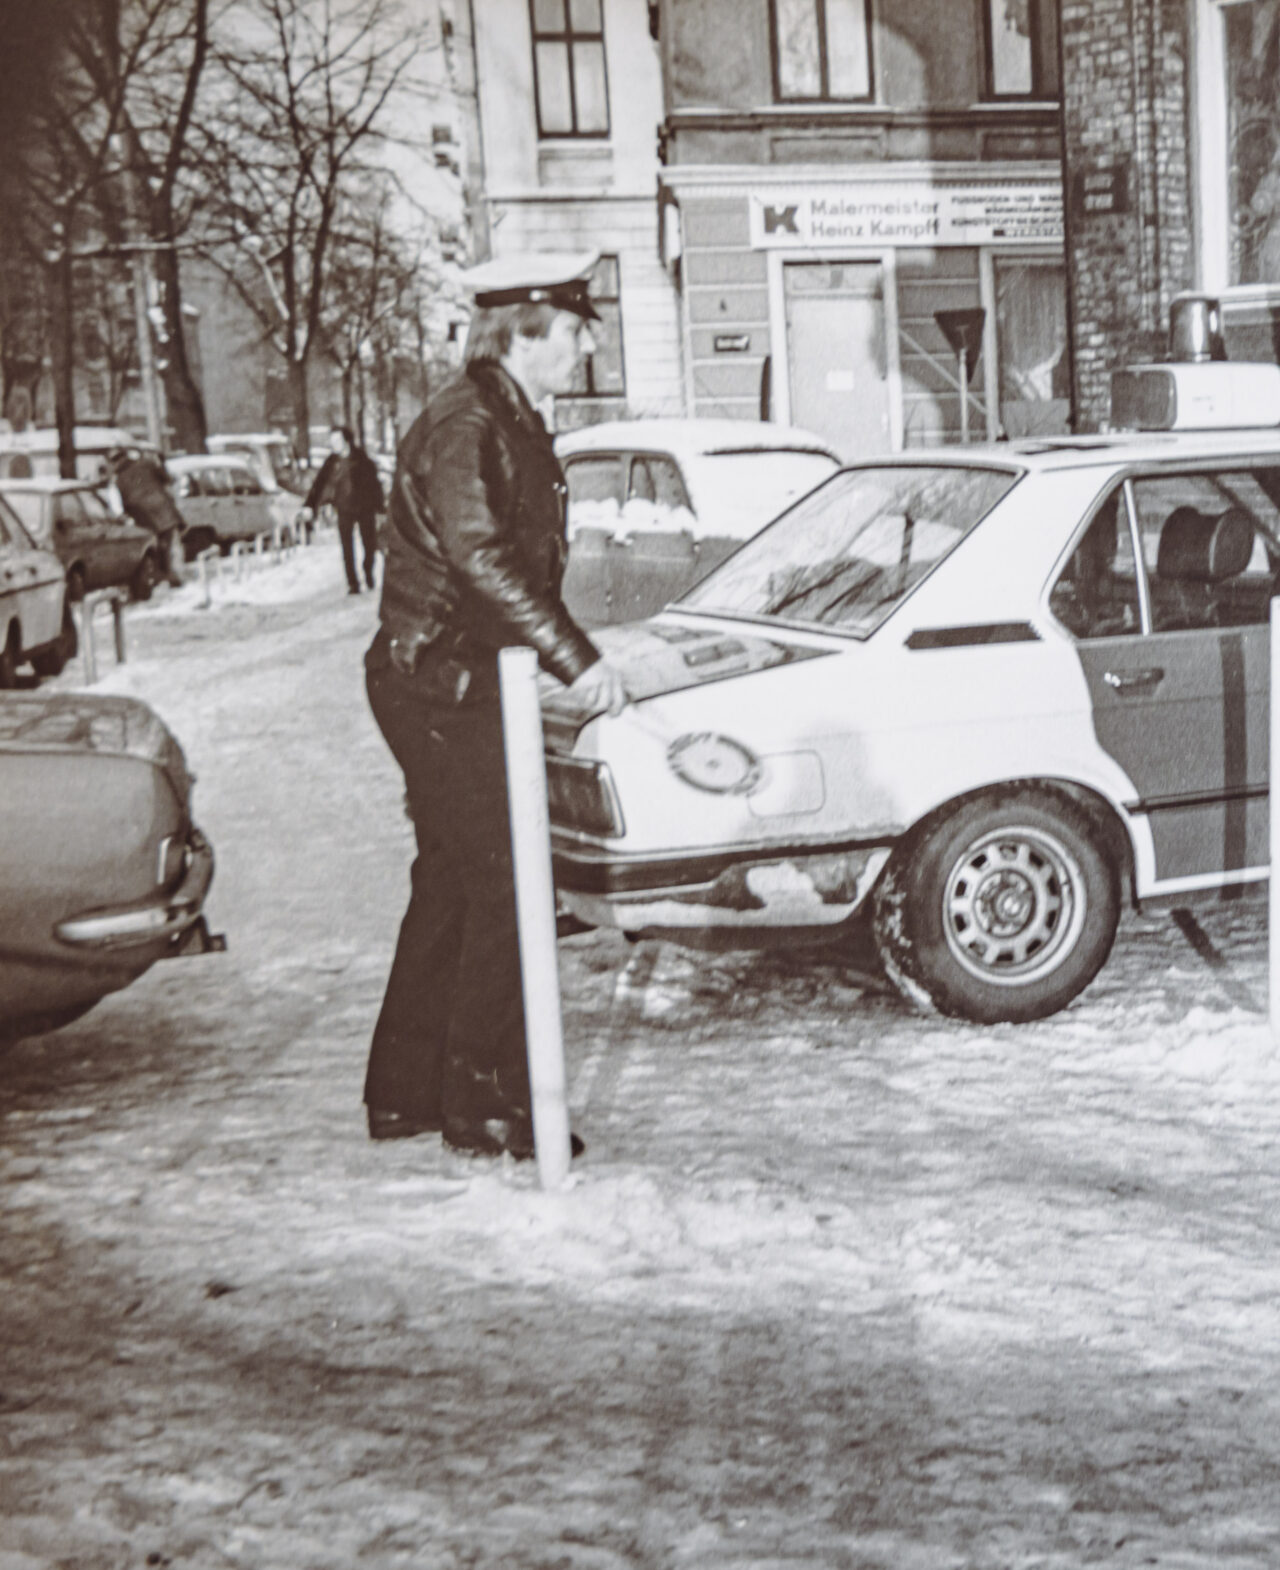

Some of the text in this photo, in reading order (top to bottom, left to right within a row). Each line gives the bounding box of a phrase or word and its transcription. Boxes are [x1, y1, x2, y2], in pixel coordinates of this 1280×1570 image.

[810, 200, 939, 215] Malermeister
[763, 205, 799, 234] K
[811, 217, 940, 237] Heinz Kampff
